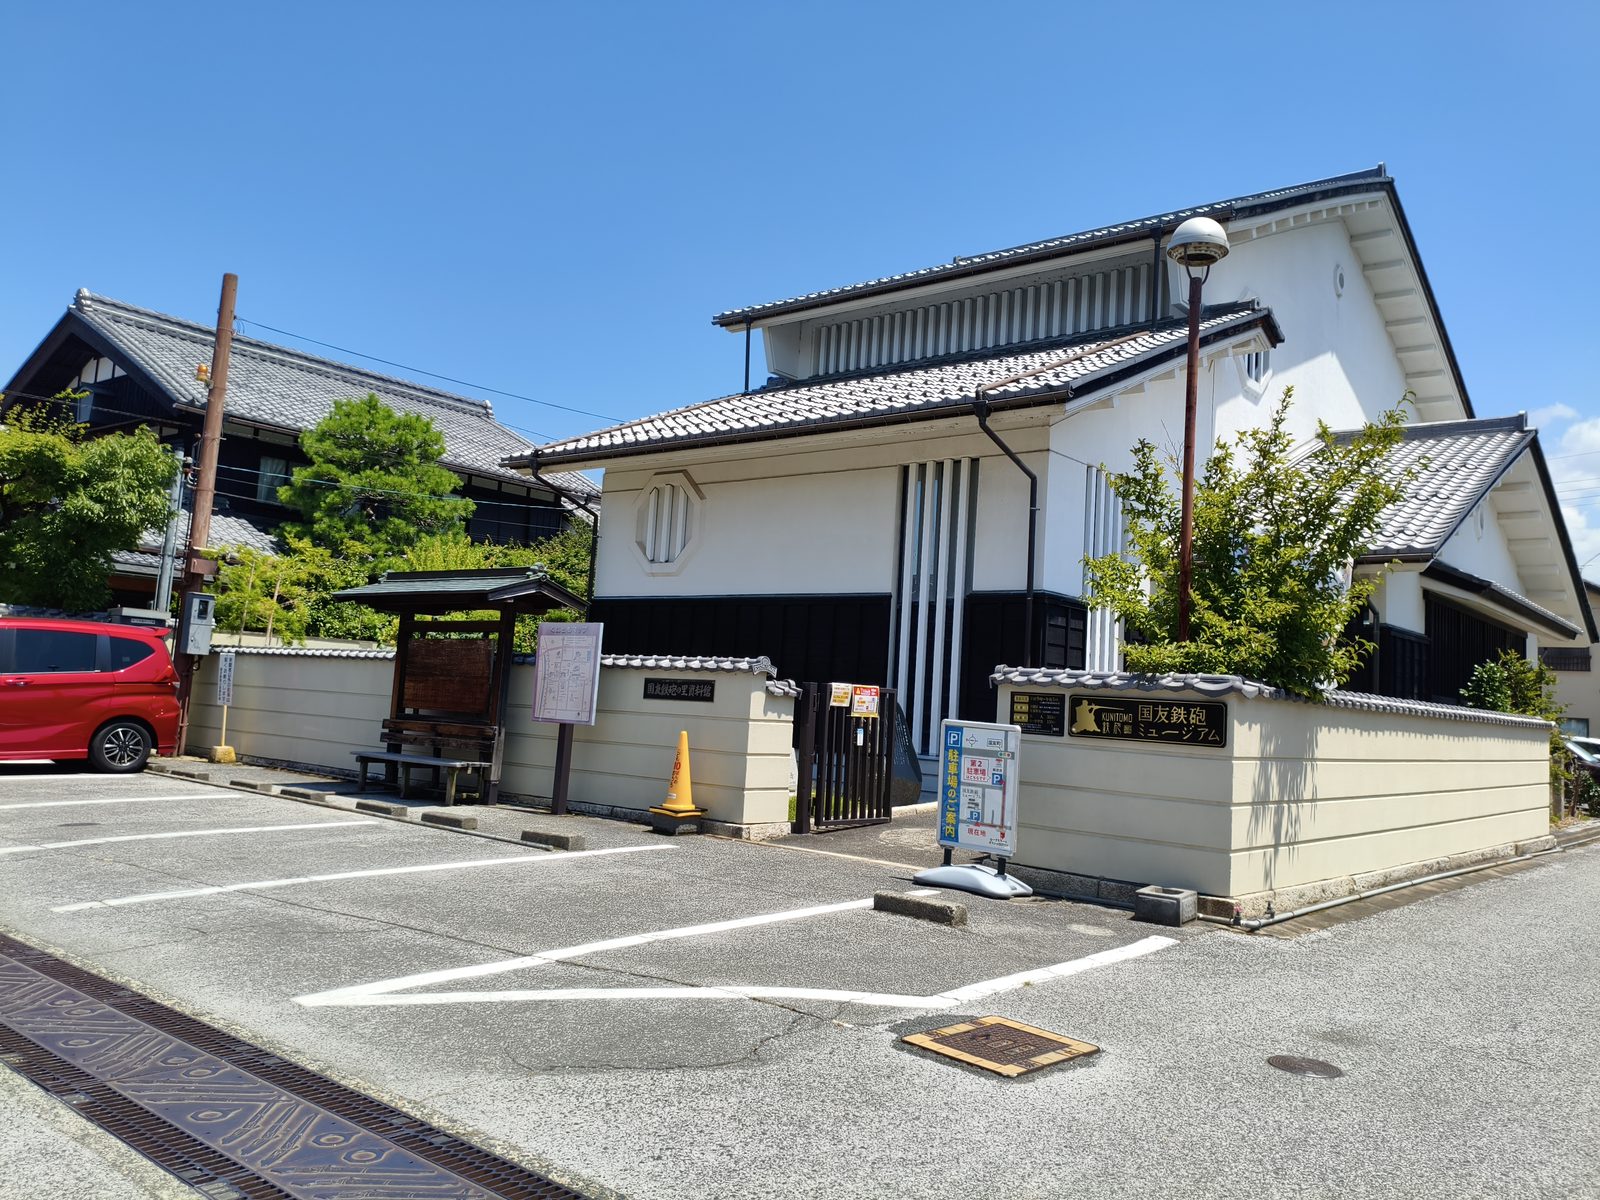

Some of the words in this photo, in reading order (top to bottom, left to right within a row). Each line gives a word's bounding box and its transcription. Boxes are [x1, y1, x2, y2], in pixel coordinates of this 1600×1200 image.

[647, 682, 712, 697] 国友鉄砲の里資料館
[1101, 712, 1133, 723] KUNITOMO
[1138, 704, 1206, 726] 国友鉄砲
[950, 733, 958, 744] P
[1138, 724, 1220, 742] ミュージアム
[970, 760, 983, 768] 第2
[966, 768, 986, 777] 駐車場
[993, 774, 1001, 784] P
[946, 750, 959, 838] 駐車場のご案内
[967, 828, 986, 837] 現在地
